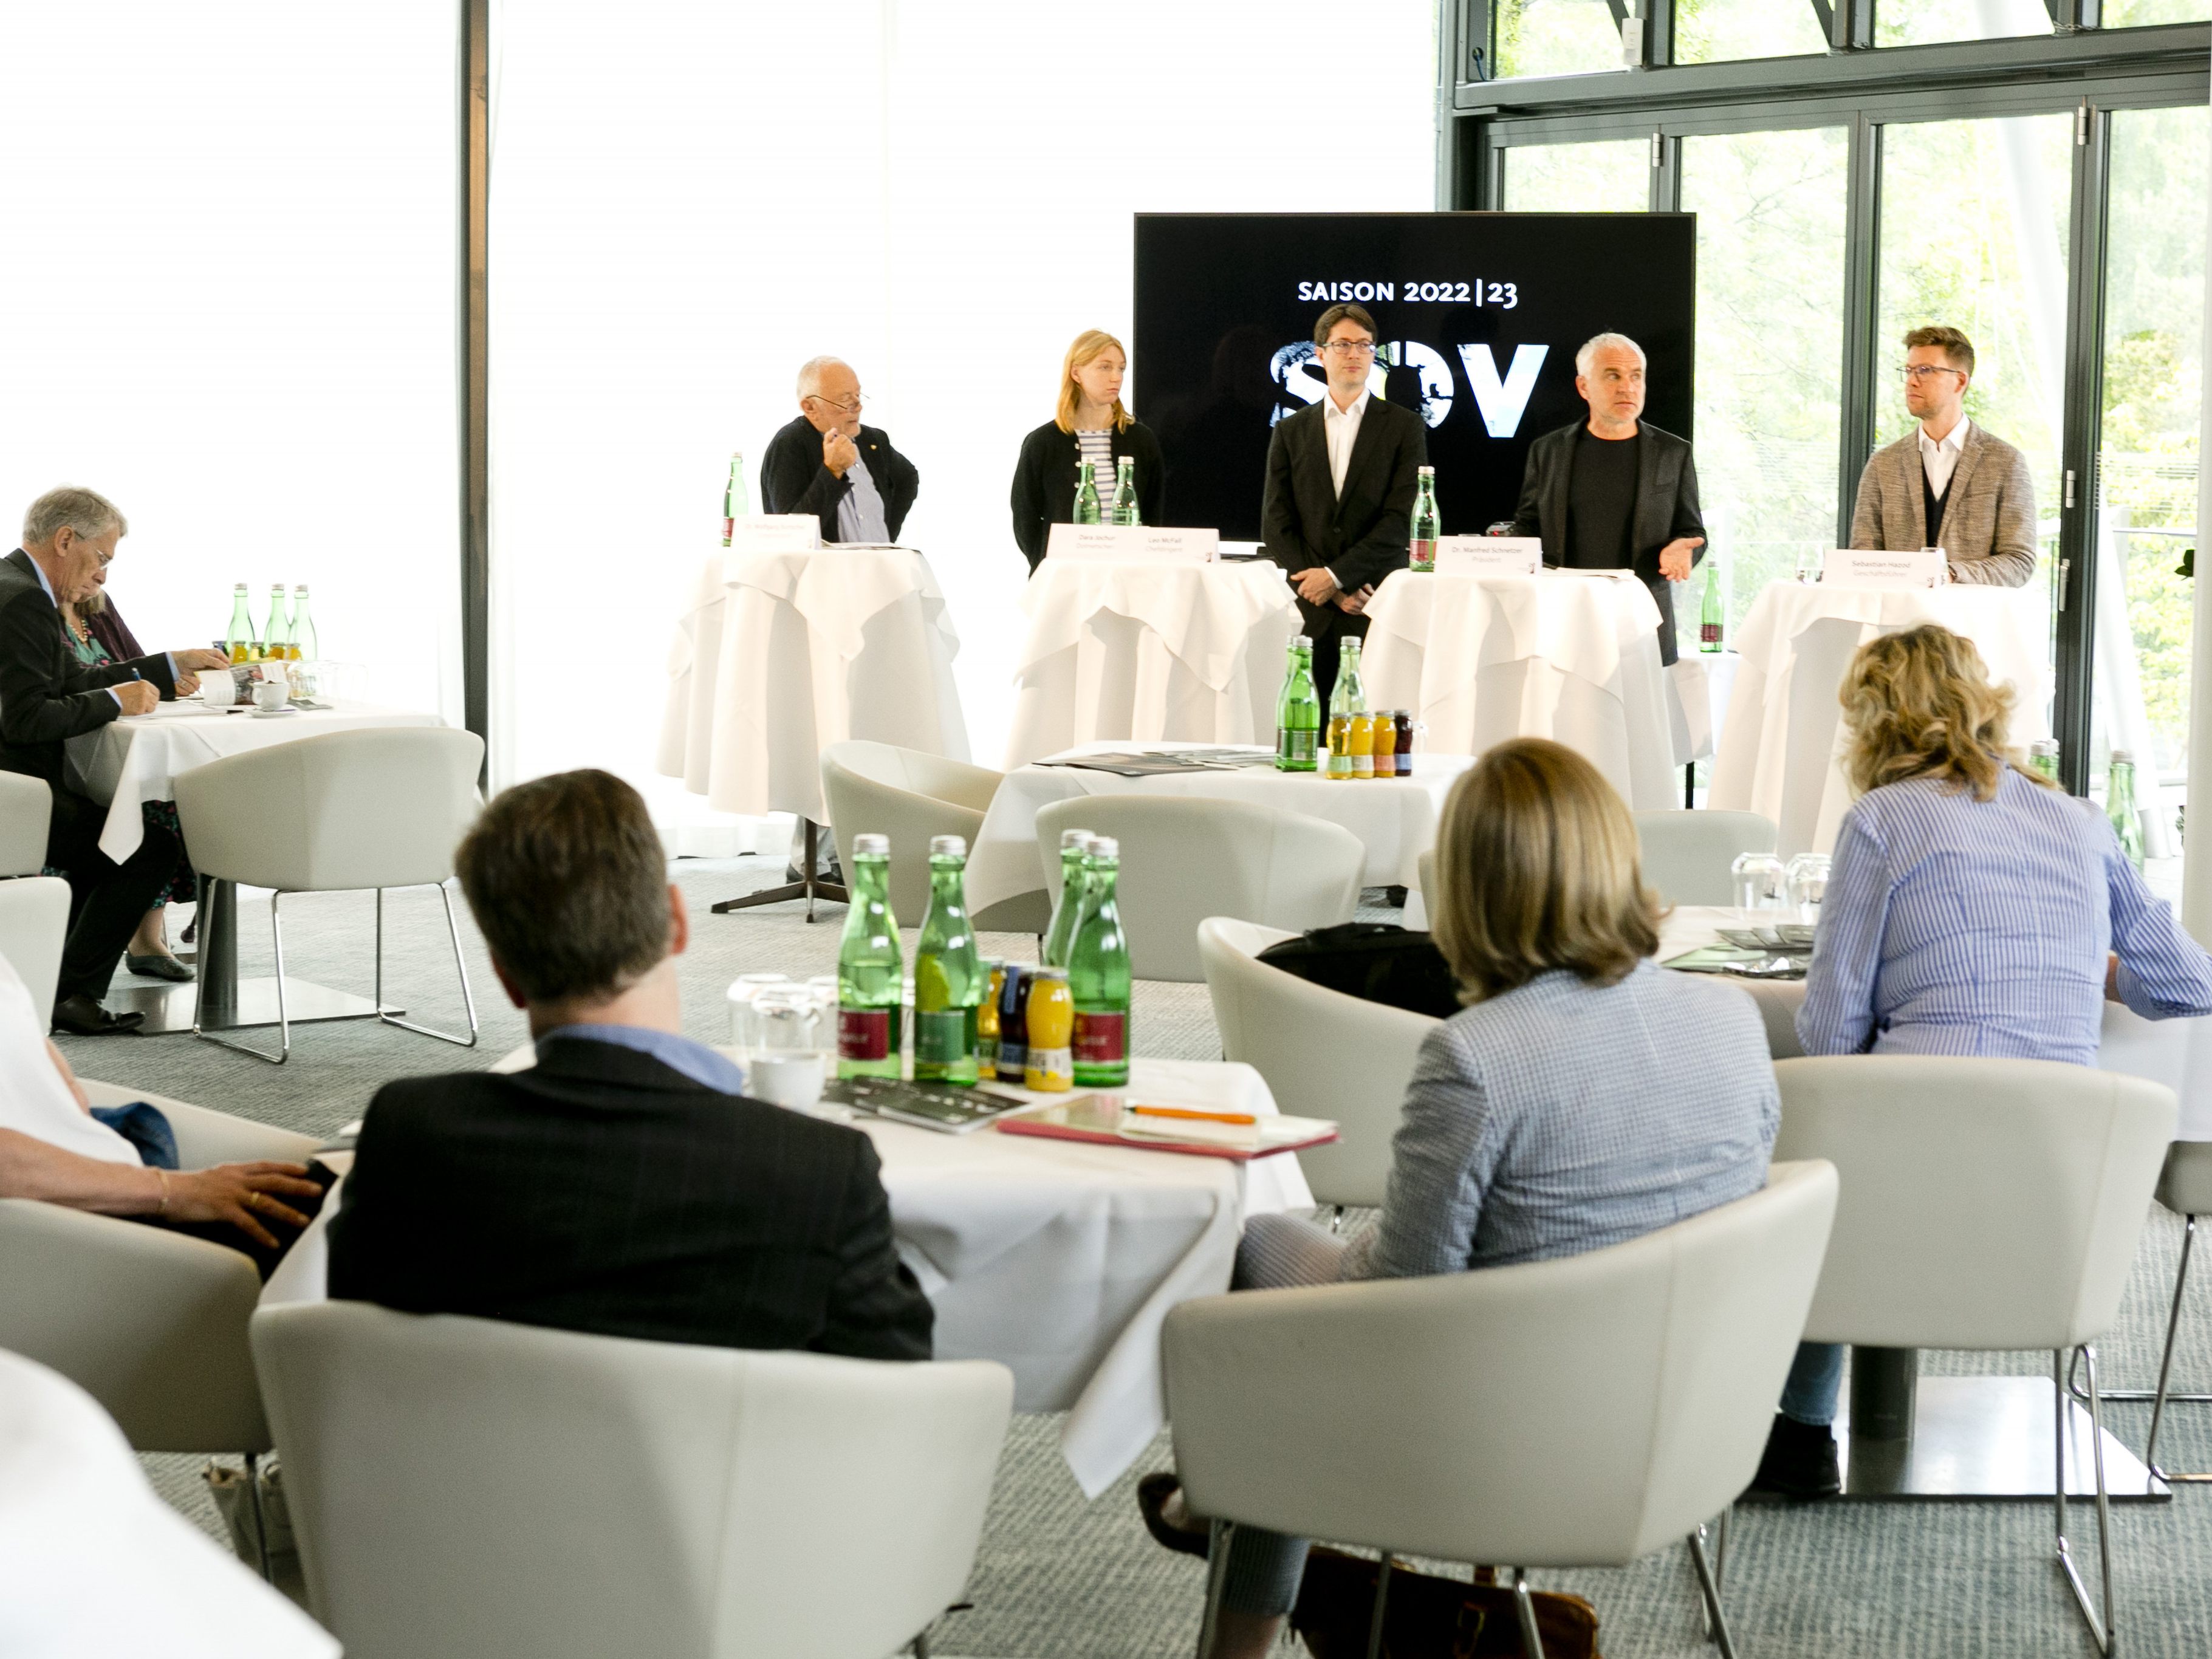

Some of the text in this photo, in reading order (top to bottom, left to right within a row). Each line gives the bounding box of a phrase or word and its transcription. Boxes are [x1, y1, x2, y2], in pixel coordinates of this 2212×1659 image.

[1298, 278, 1518, 309] SAISON 2022|23
[1269, 340, 1550, 438] SOV
